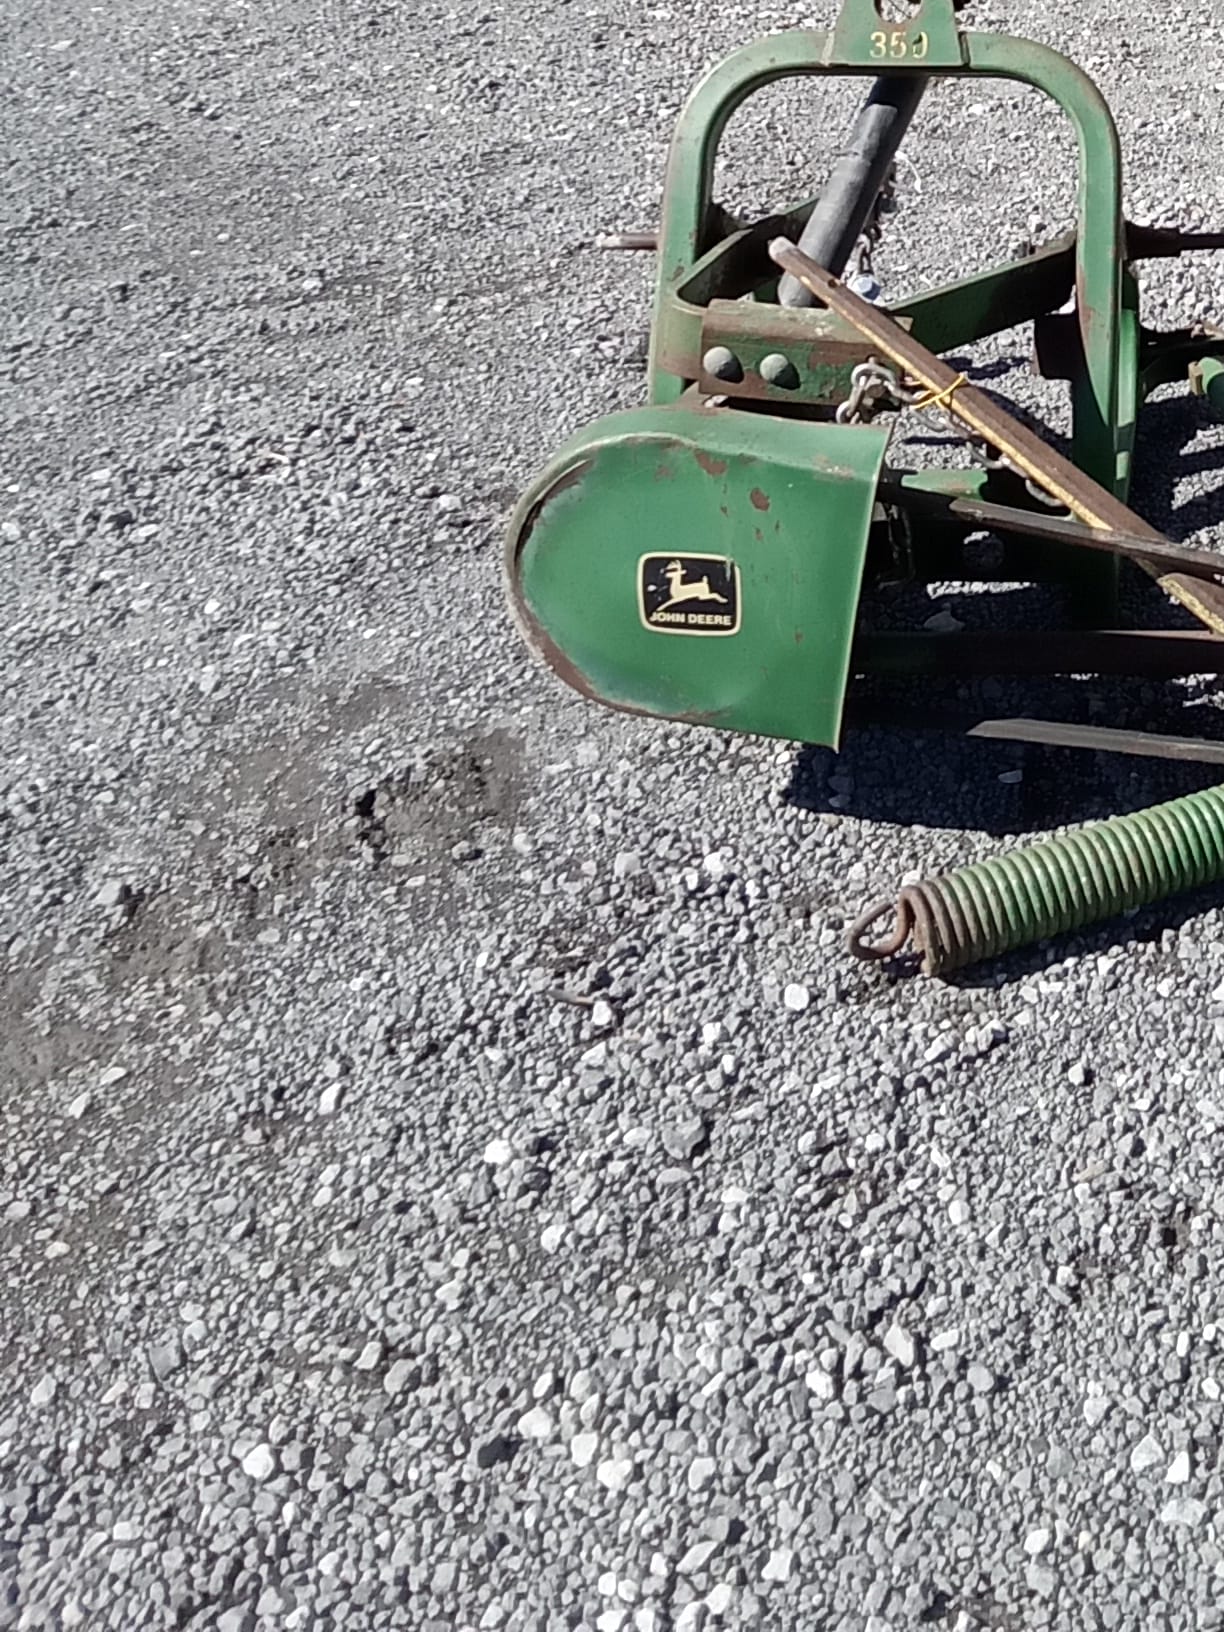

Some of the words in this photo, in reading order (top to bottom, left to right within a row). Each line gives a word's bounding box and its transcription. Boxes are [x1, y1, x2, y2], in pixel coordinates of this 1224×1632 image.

[869, 31, 928, 58] 350
[649, 611, 686, 623] JOHN
[687, 613, 732, 626] DEERE
